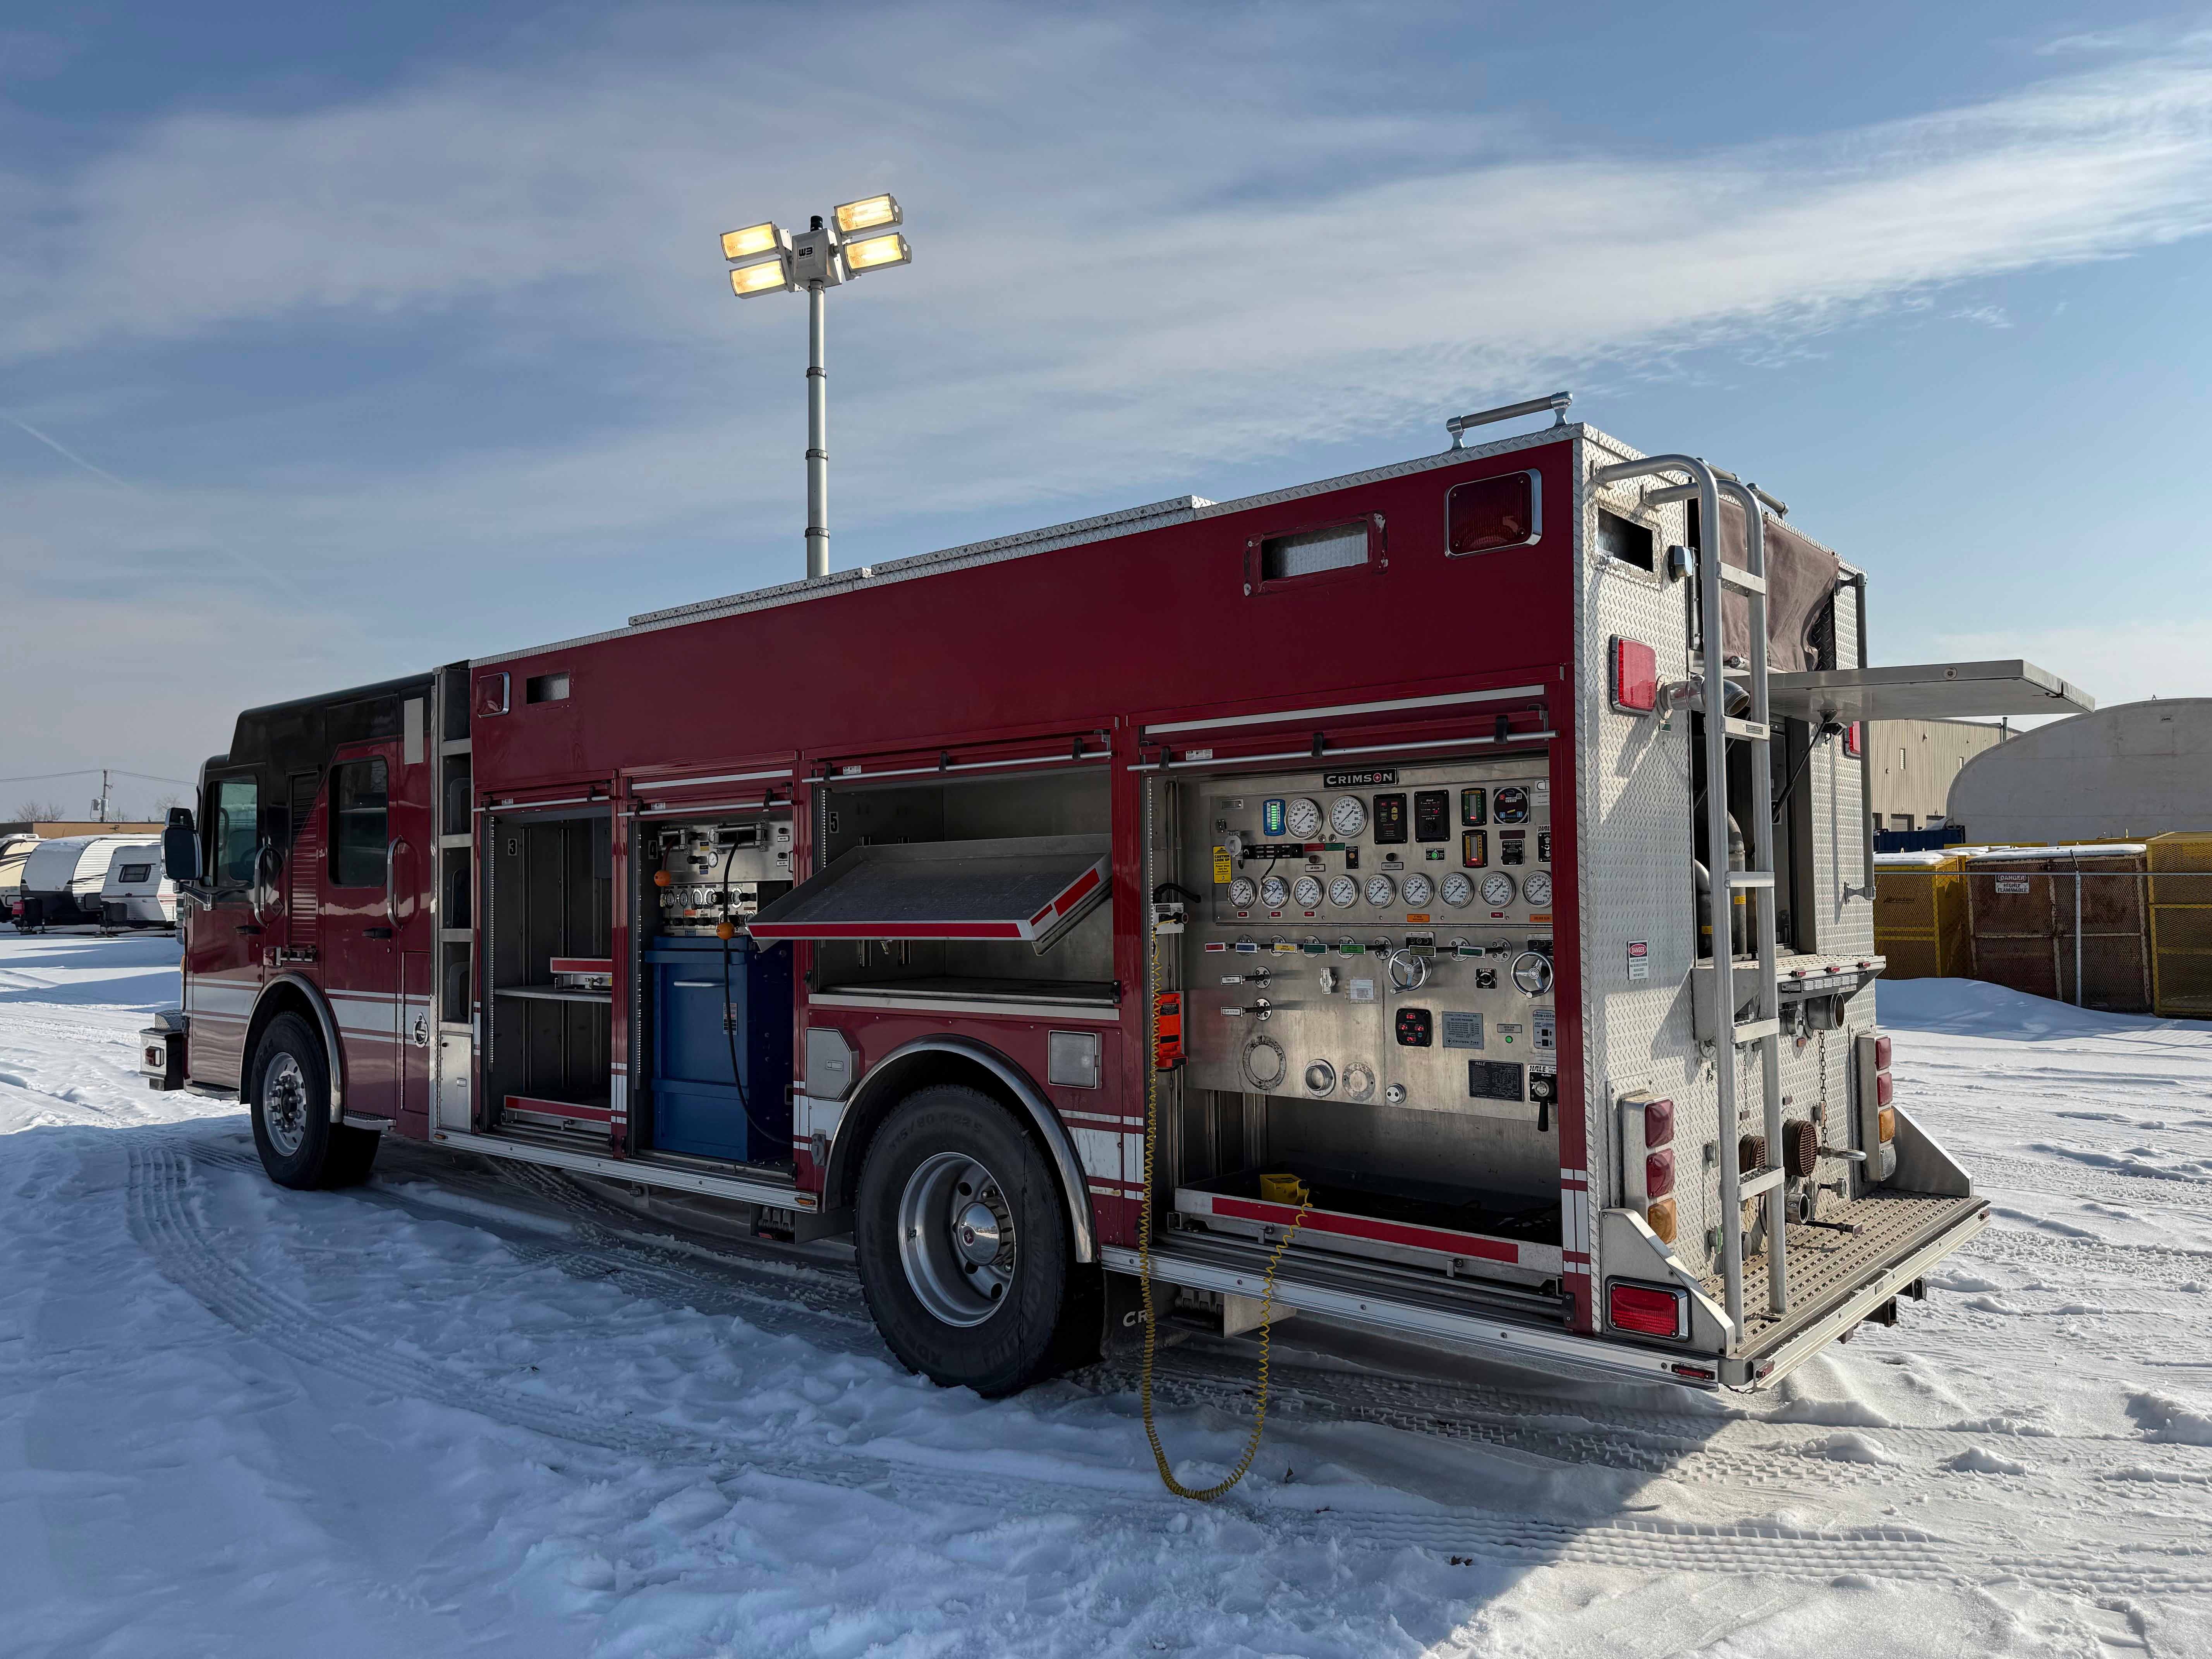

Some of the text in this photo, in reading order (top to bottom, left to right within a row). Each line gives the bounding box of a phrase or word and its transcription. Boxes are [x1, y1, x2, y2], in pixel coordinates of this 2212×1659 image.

[1326, 772, 1393, 785] CRIMSON
[830, 813, 837, 832] 5
[509, 840, 516, 855] 3
[649, 841, 657, 859] 4
